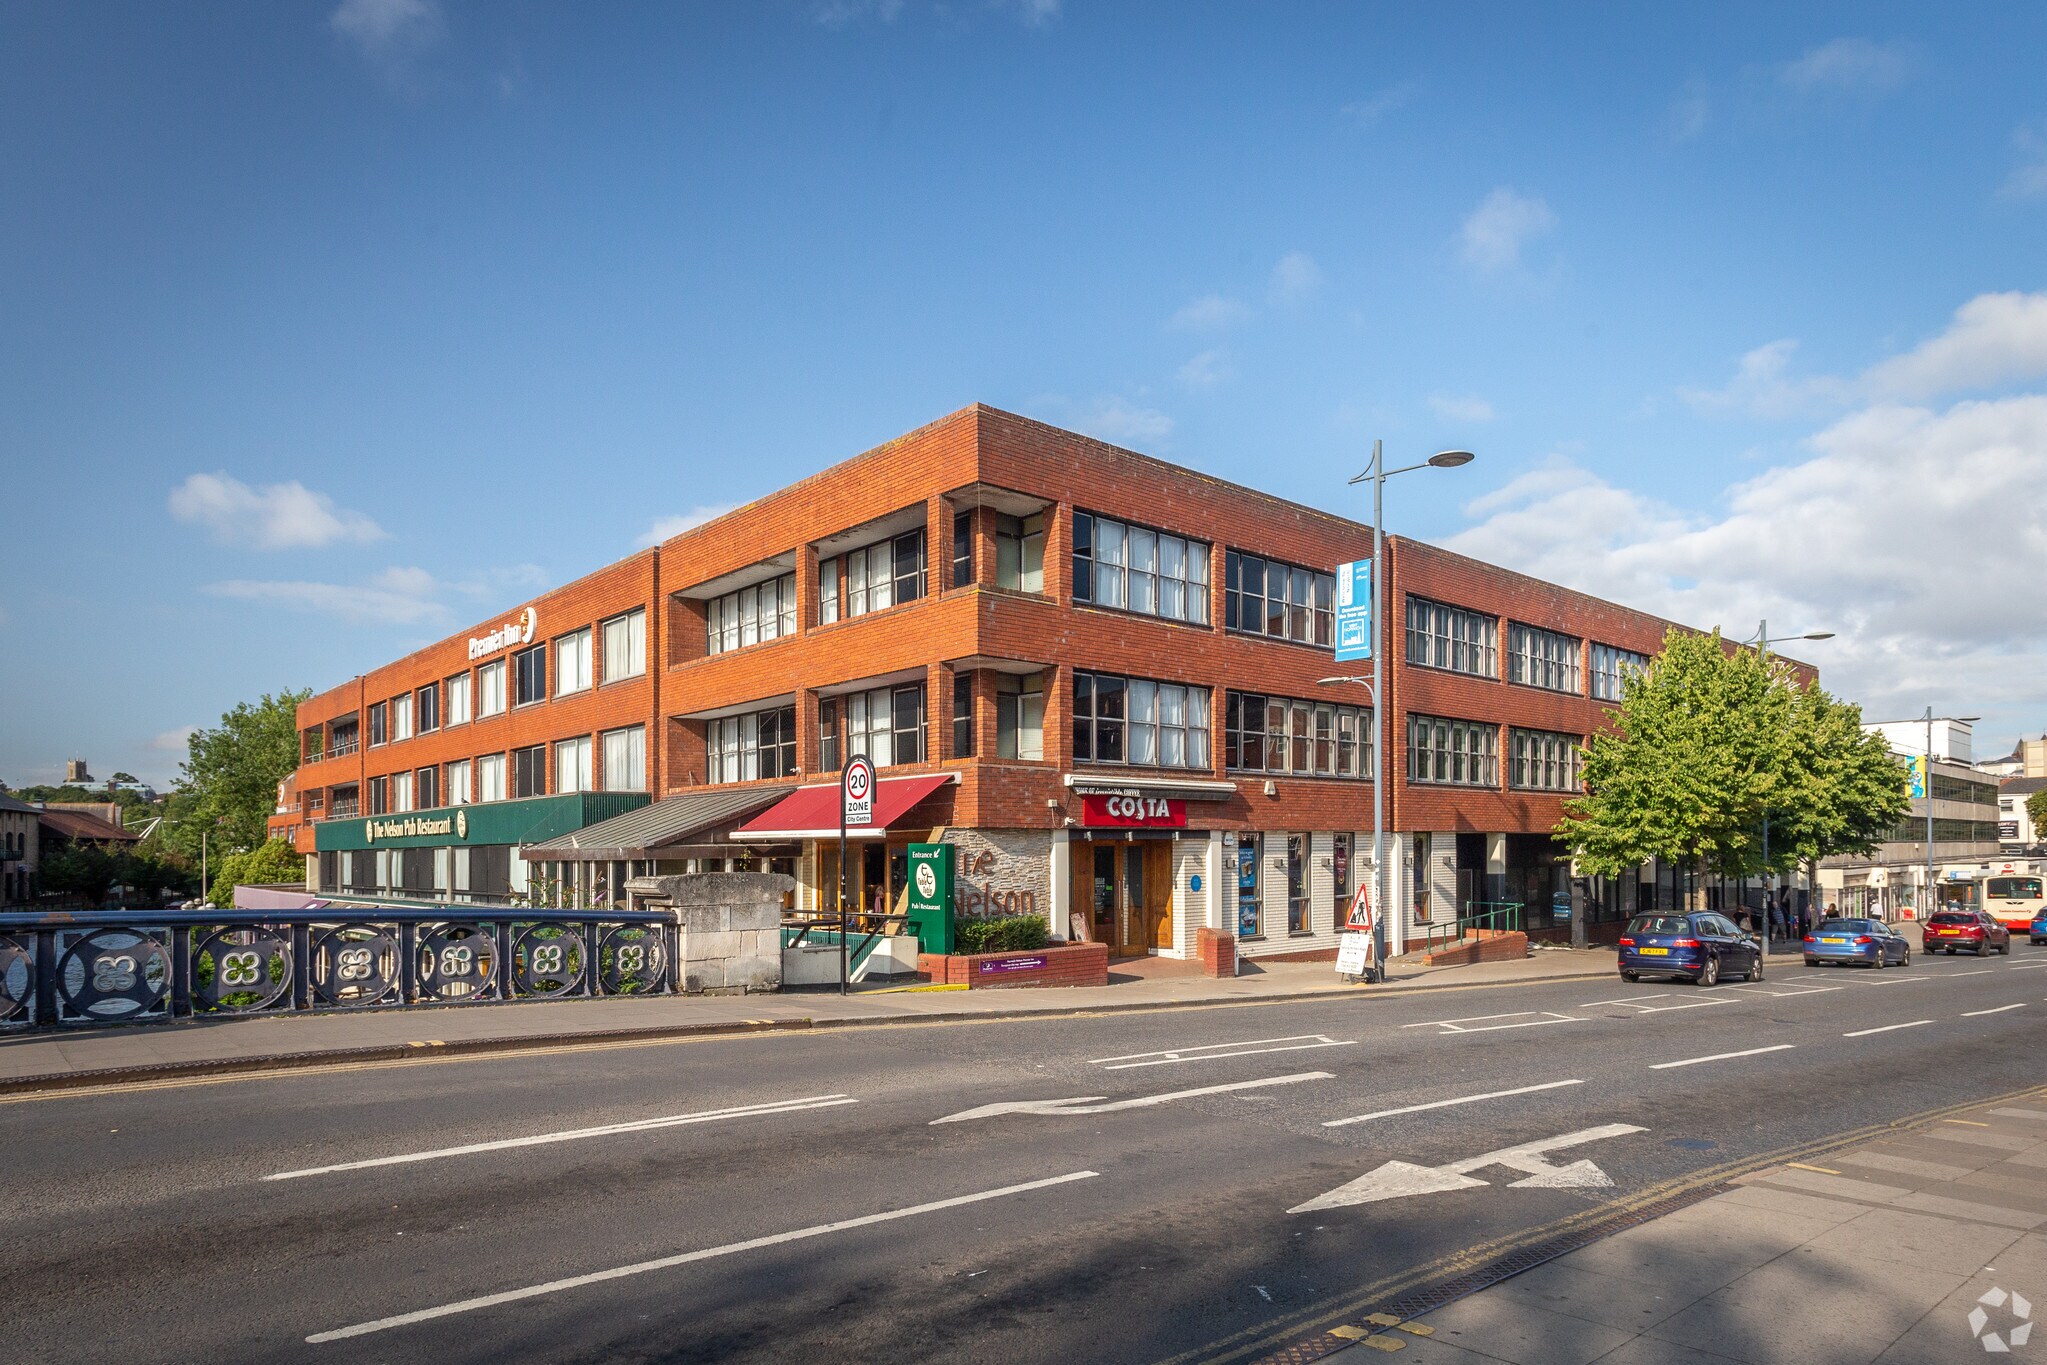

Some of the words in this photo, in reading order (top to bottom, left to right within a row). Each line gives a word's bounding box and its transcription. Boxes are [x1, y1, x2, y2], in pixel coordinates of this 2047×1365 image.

[504, 623, 521, 648] Inn
[851, 774, 866, 789] 20
[848, 802, 868, 812] ZONE
[1106, 796, 1170, 821] COSTA
[373, 821, 384, 838] The
[384, 820, 404, 837] Nelson
[404, 817, 416, 836] Pub
[417, 816, 451, 835] Restaurant
[912, 851, 933, 859] Entrance
[954, 881, 1033, 918] Nelson
